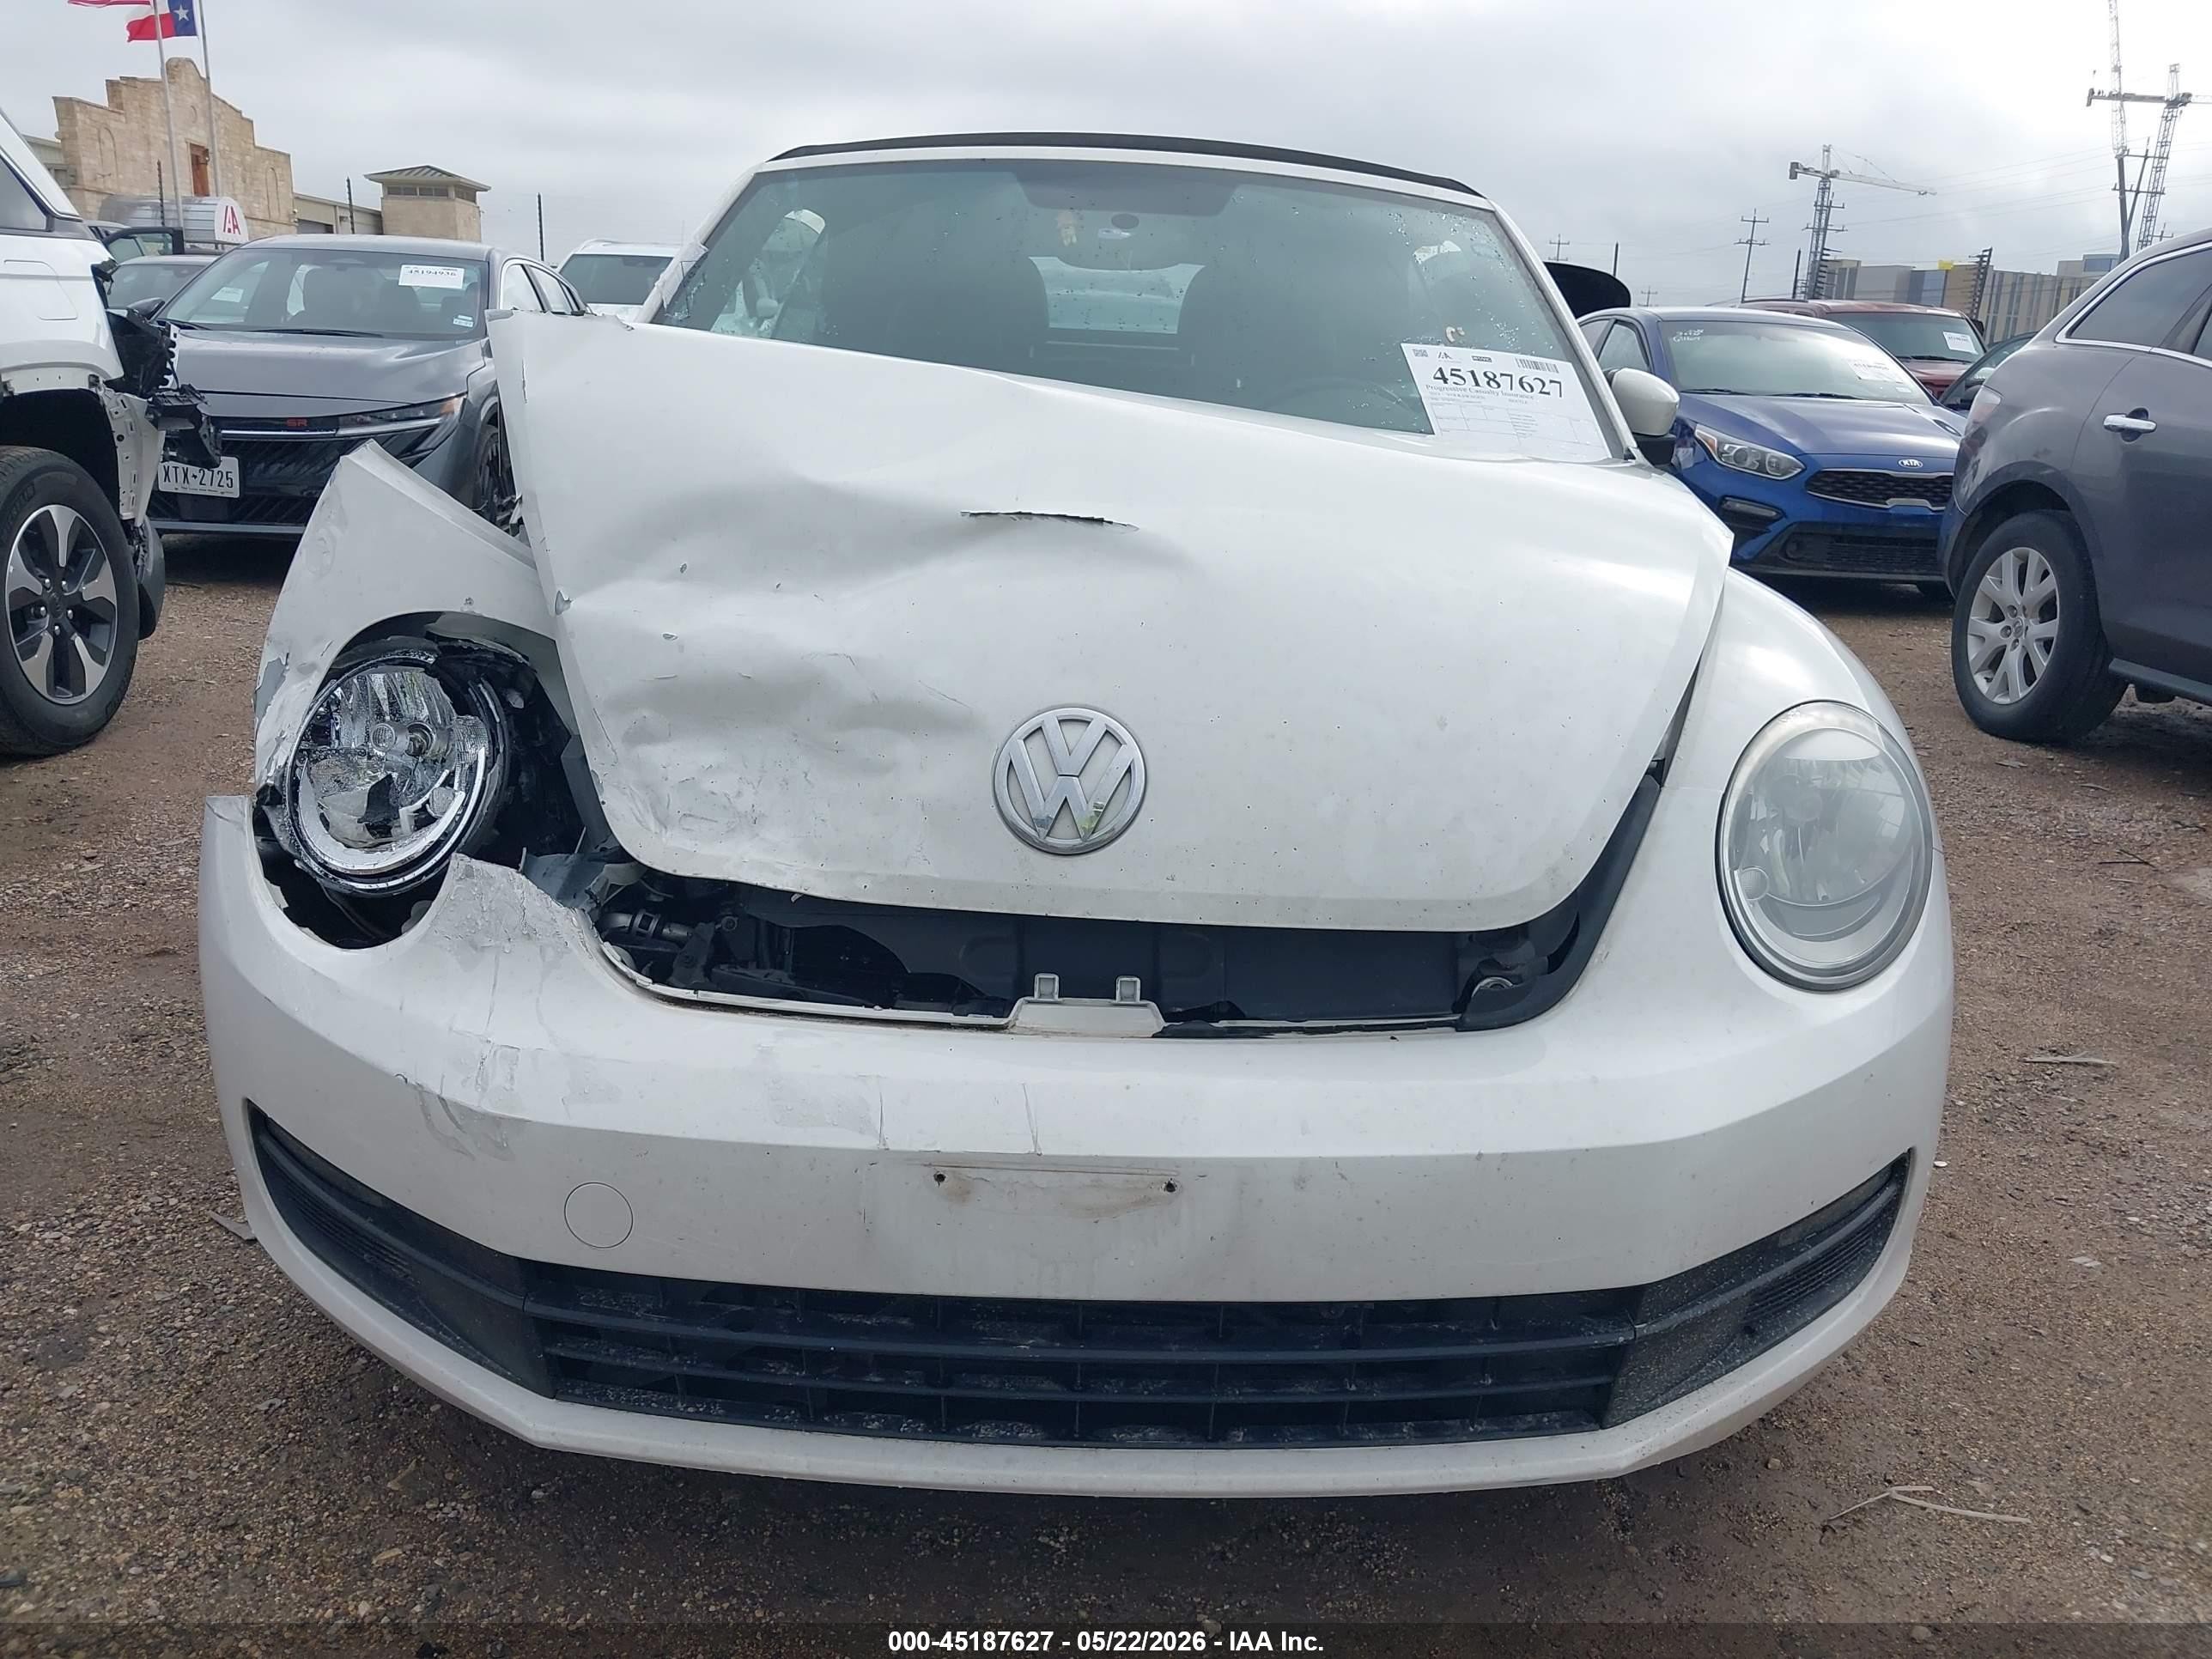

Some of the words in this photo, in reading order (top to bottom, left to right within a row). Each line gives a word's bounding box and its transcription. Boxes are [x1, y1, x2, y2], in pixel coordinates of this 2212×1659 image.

[1433, 367, 1563, 398] 45187627
[1425, 384, 1468, 393] Progressive
[1468, 386, 1499, 397] Casualty
[1501, 391, 1534, 399] Insurance
[286, 418, 307, 427] SR
